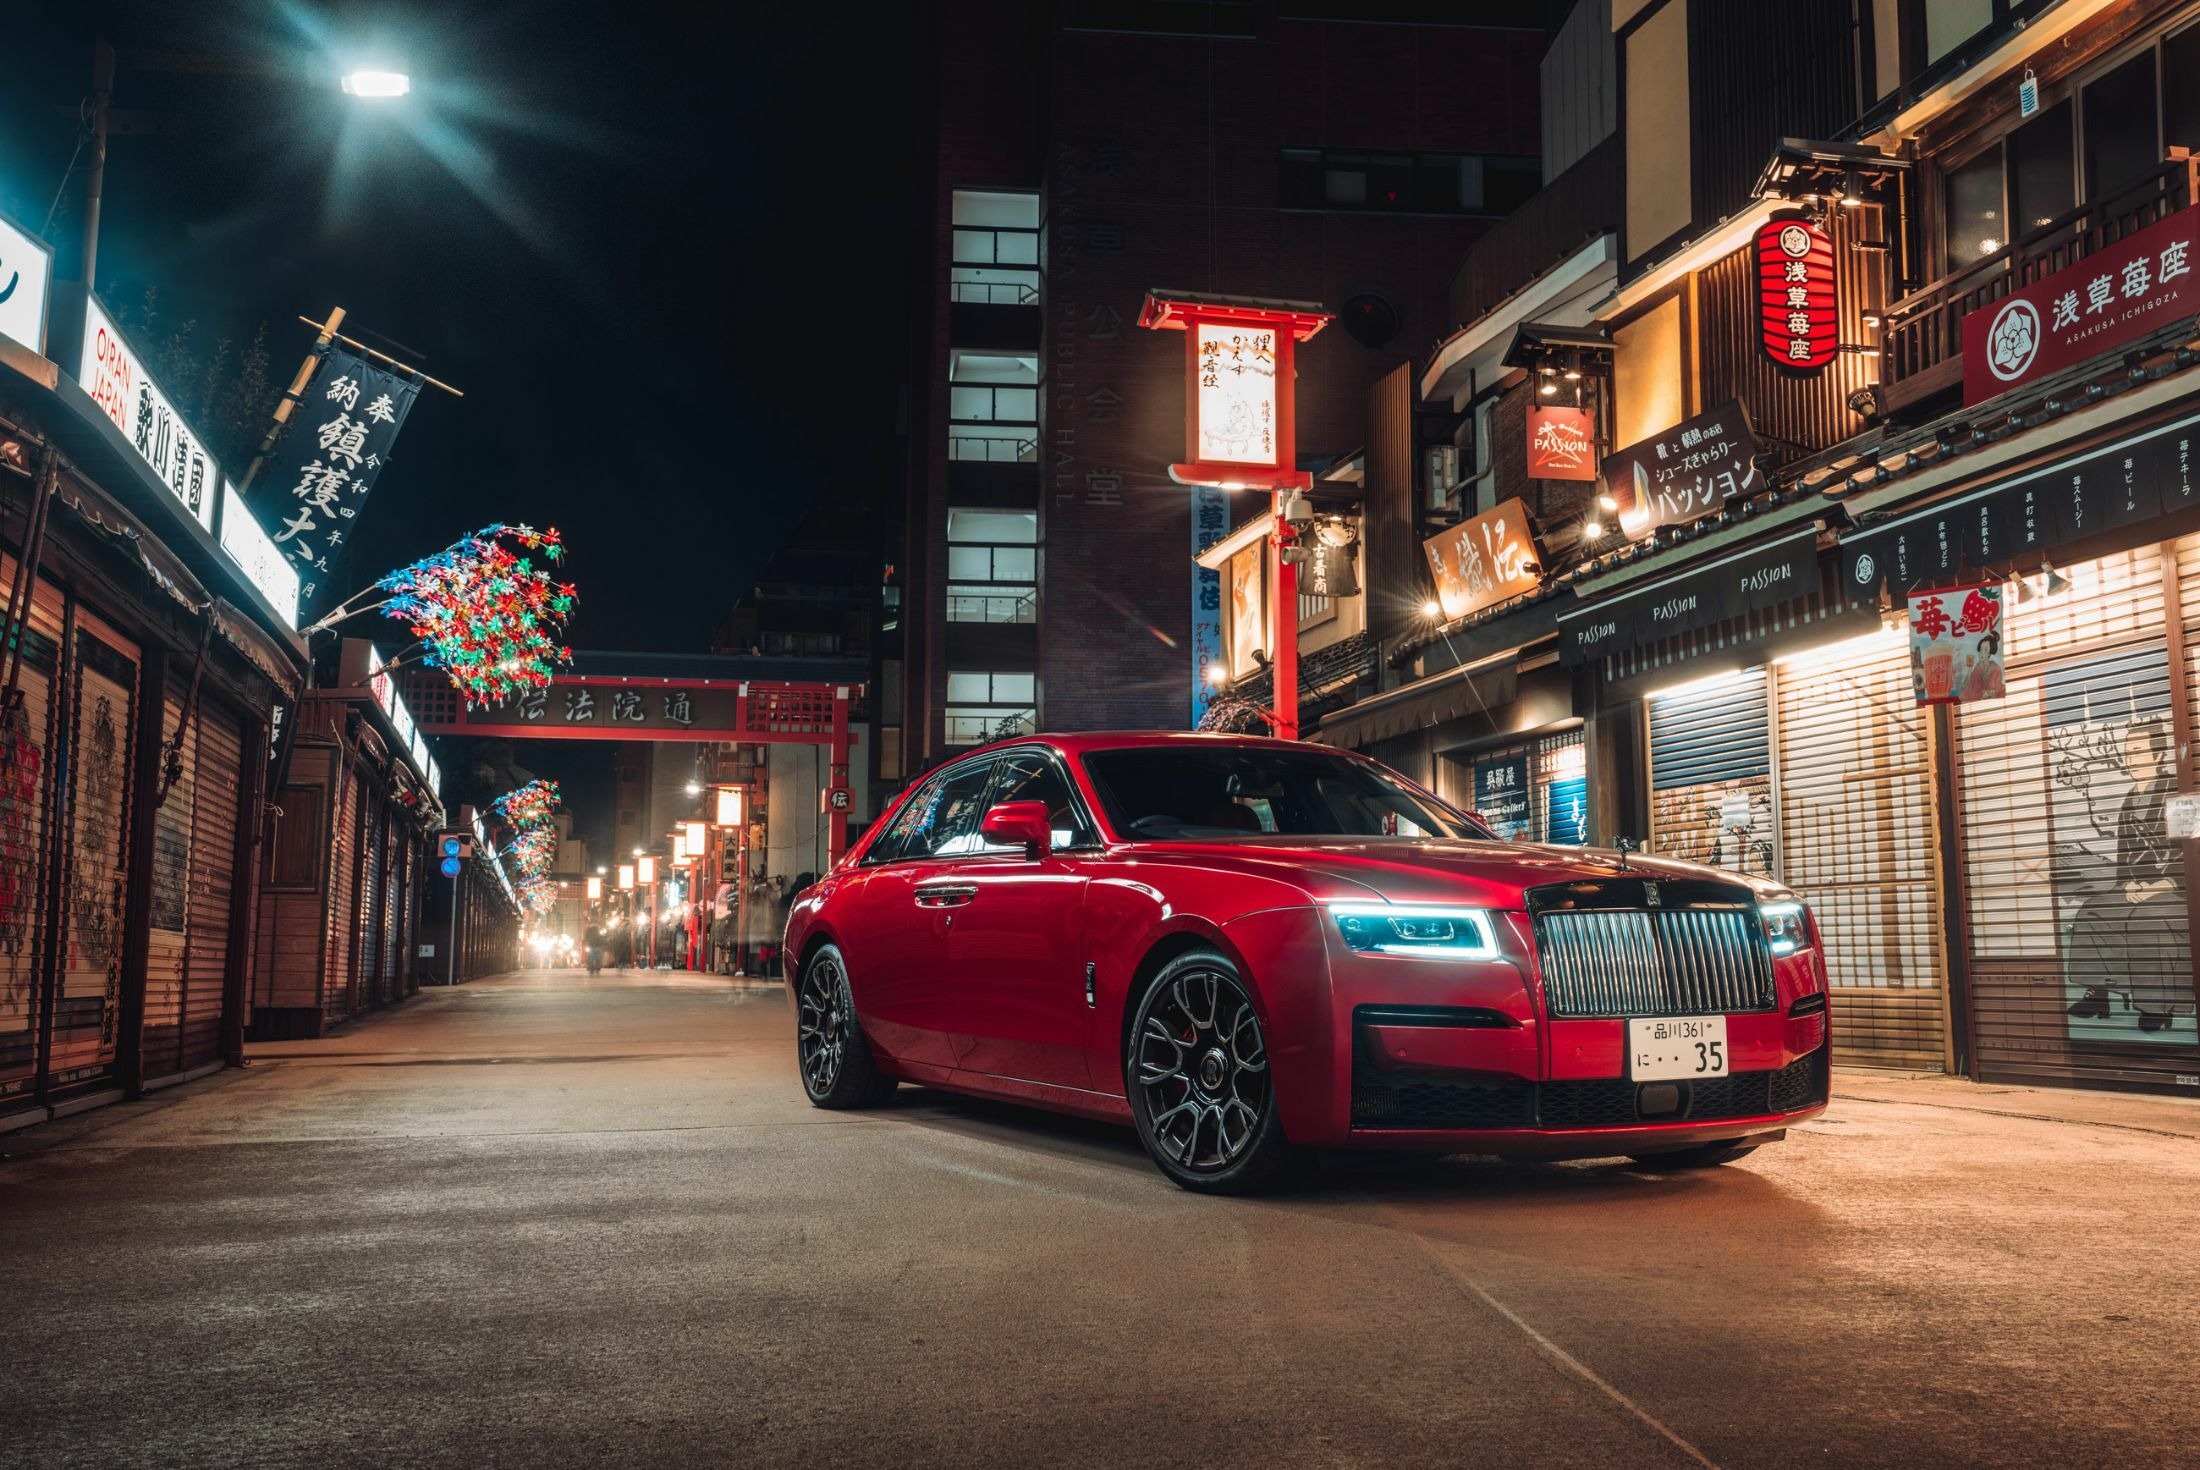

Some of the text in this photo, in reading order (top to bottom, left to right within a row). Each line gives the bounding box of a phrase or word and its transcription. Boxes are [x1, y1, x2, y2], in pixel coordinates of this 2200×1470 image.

[1785, 262, 1811, 360] 浅草苺座
[2052, 240, 2191, 333] 浅草苺座
[2066, 291, 2179, 345] ASAKUSA ICHIGOZA
[97, 328, 131, 395] OIRAN
[91, 367, 127, 433] JAPAN
[1055, 427, 1076, 508] HALL
[1534, 438, 1587, 453] PASSION
[2179, 440, 2191, 496] 苺テキーラ
[273, 412, 370, 568] 鎮護大
[1658, 460, 1755, 520] パッション
[2124, 458, 2135, 511] 苺ビール
[300, 453, 381, 615] 令和四年九月
[1741, 563, 1791, 592] PASSION
[1578, 622, 1616, 644] PASSION
[1653, 595, 1697, 620] PASSION
[515, 689, 692, 724] 伝法院通
